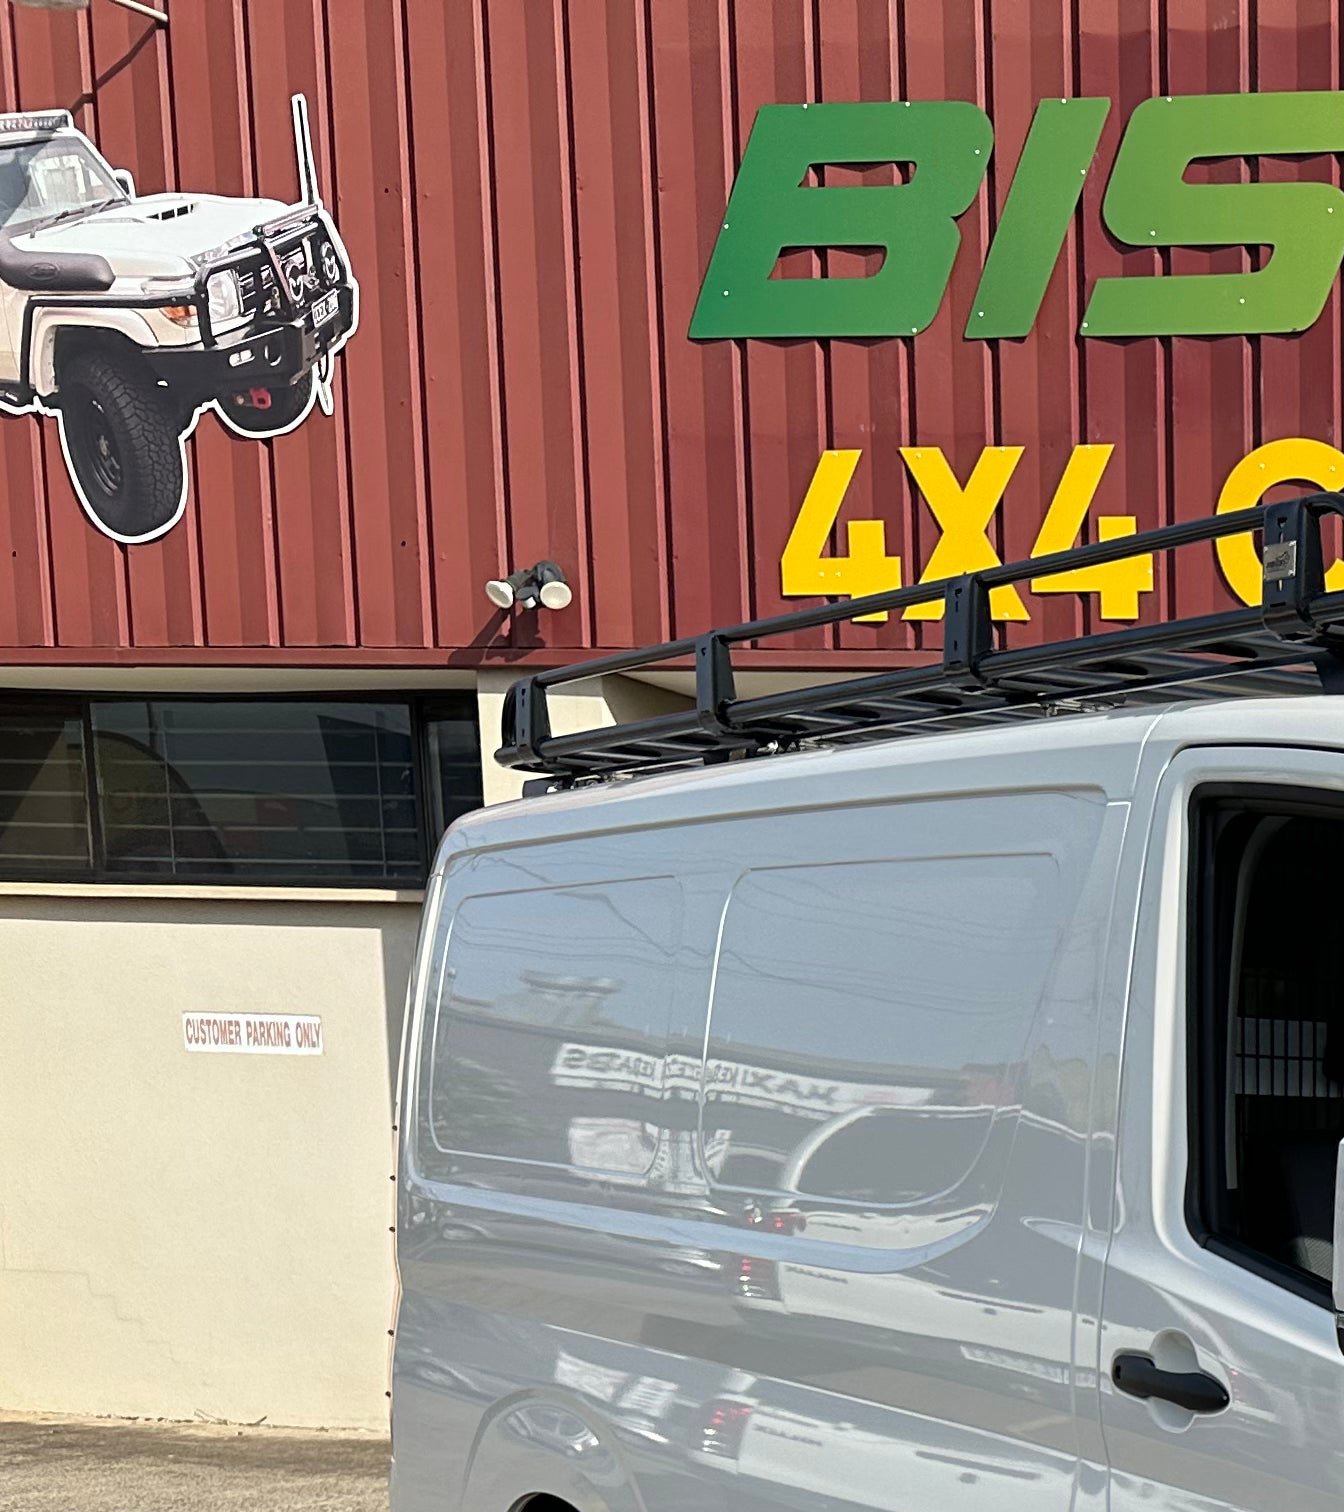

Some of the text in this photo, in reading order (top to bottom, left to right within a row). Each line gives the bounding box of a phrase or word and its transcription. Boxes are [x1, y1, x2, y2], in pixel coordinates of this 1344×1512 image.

[781, 443, 1154, 622] 4X4
[185, 1018, 321, 1048] CUSTOMER PARKING ONLY
